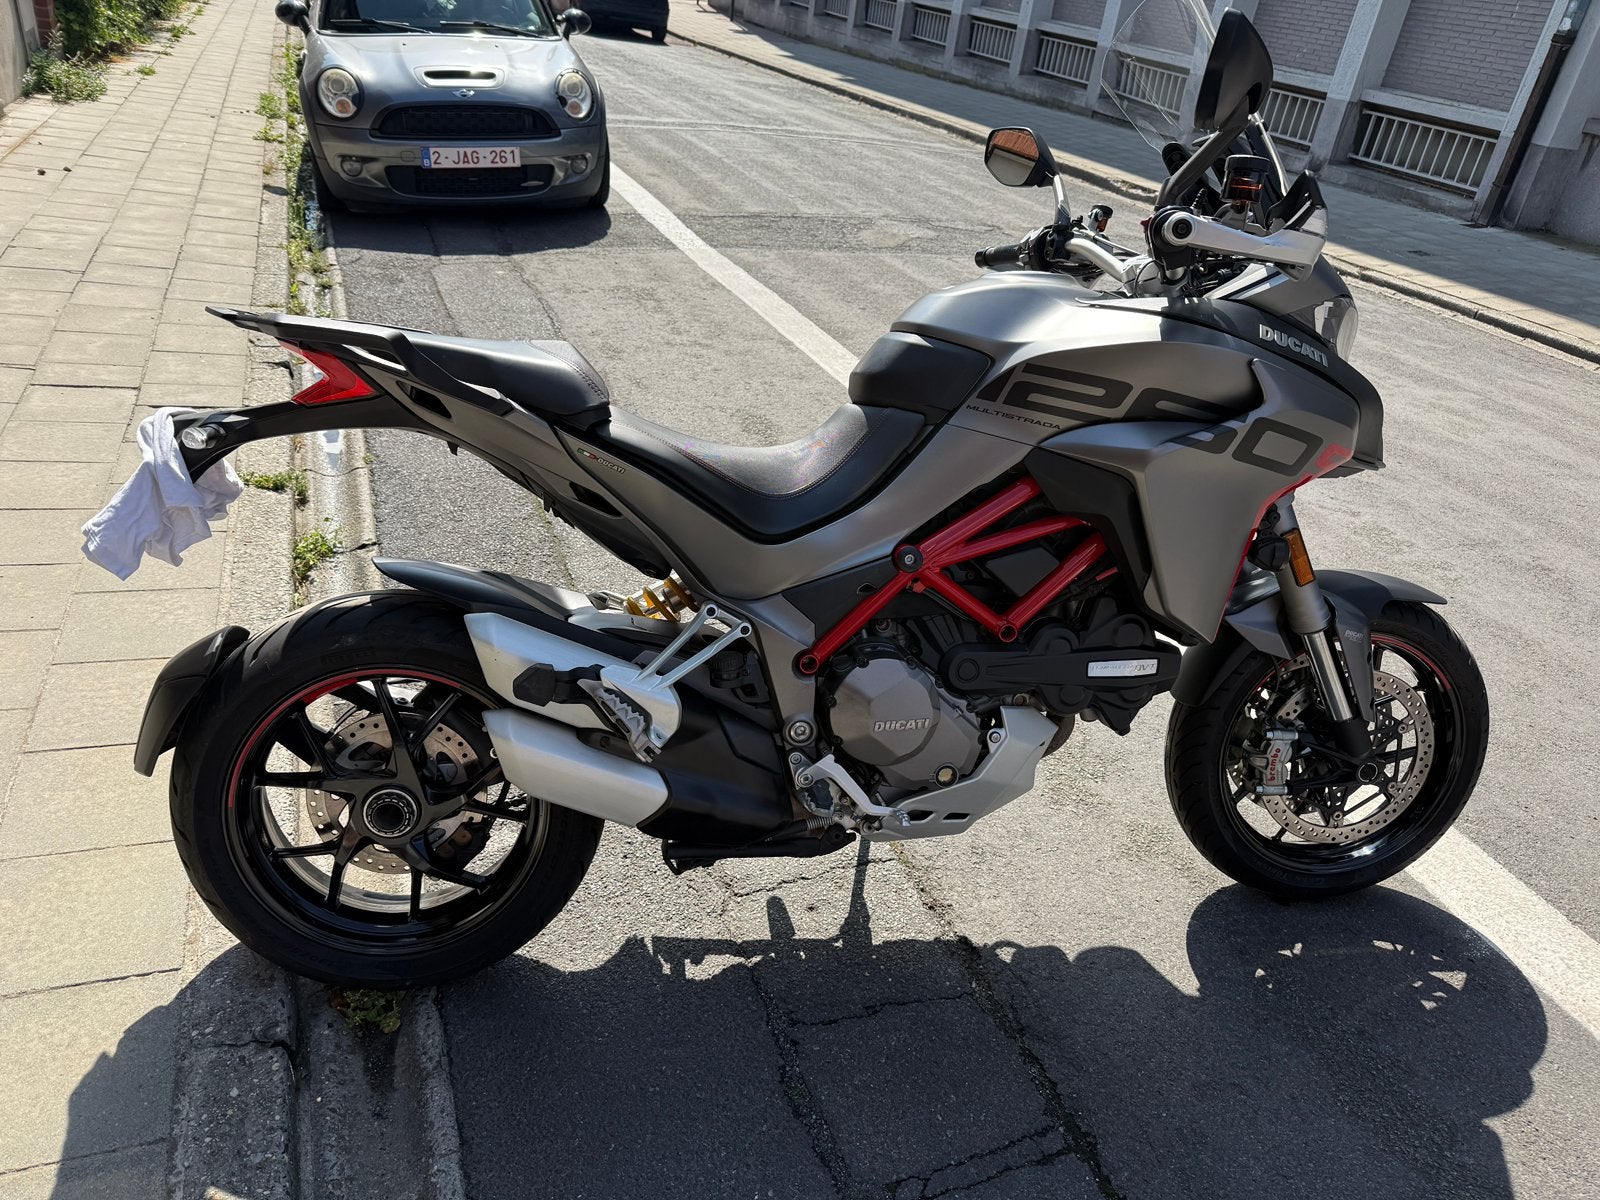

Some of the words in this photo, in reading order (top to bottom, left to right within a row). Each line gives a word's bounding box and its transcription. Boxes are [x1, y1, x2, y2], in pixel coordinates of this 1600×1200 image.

[1259, 323, 1329, 368] DUCATI
[965, 404, 1061, 430] MULTISTRADA
[597, 456, 626, 475] DUCATI
[873, 718, 931, 732] DUCATI
[1268, 747, 1282, 782] brembo
